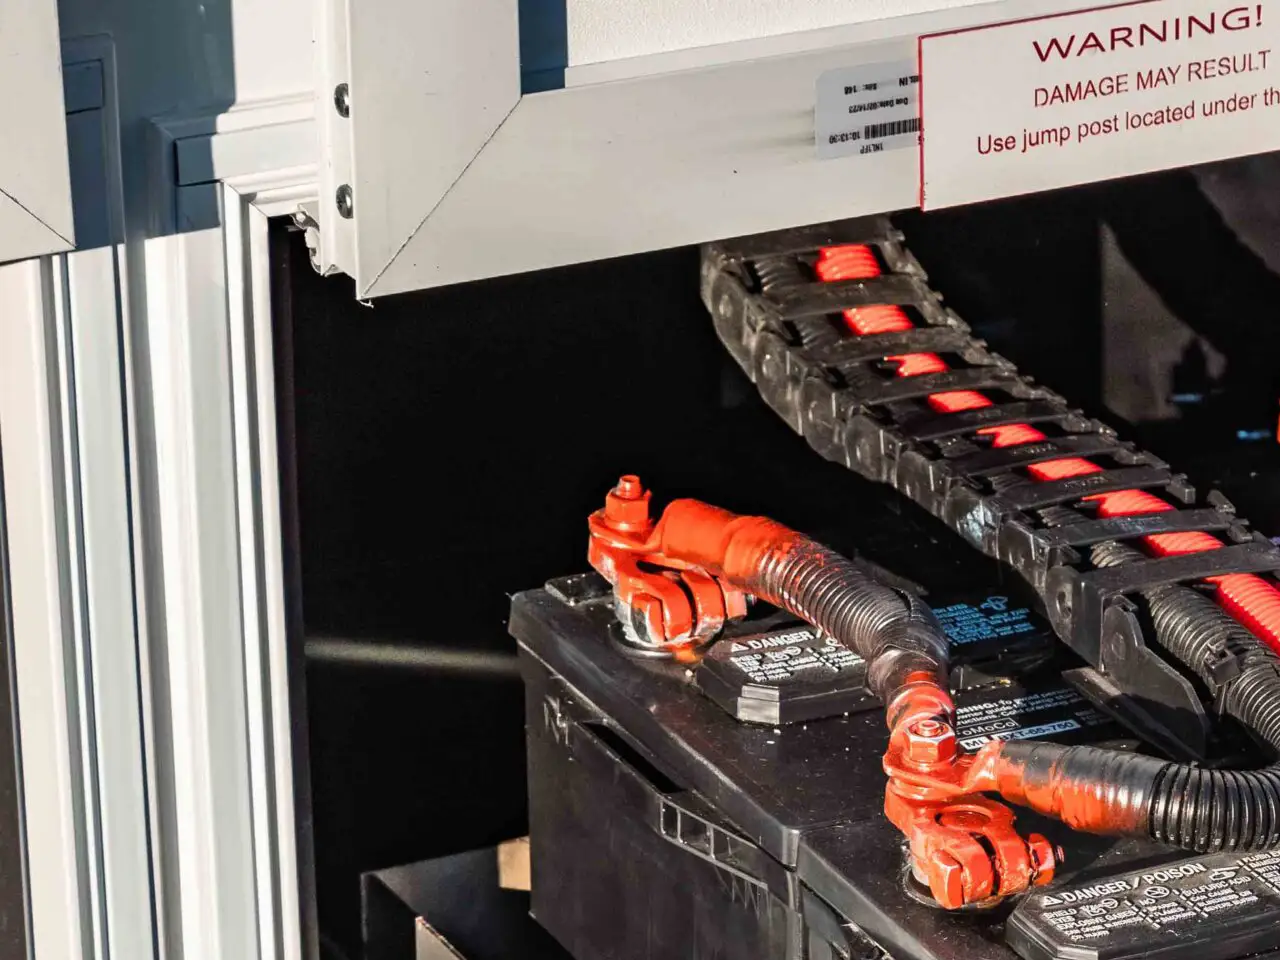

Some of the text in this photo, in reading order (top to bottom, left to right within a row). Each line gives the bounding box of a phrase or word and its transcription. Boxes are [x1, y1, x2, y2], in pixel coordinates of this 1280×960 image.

[1032, 4, 1262, 62] WARNING!
[1034, 50, 1271, 107] DAMAGE MAY RESULT
[977, 134, 1016, 155] Use
[1021, 125, 1071, 153] jump
[1077, 114, 1119, 143] post
[1125, 100, 1195, 130] located
[1202, 93, 1258, 117] under
[747, 631, 814, 649] DANGER
[957, 721, 1015, 736] oMoCo
[1061, 880, 1131, 902] DANGER
[1142, 862, 1207, 885] POISON
[1183, 876, 1252, 896] SULFURIC ACID
[1139, 898, 1156, 908] NO
[1056, 917, 1105, 931] EXPLOSIVE
